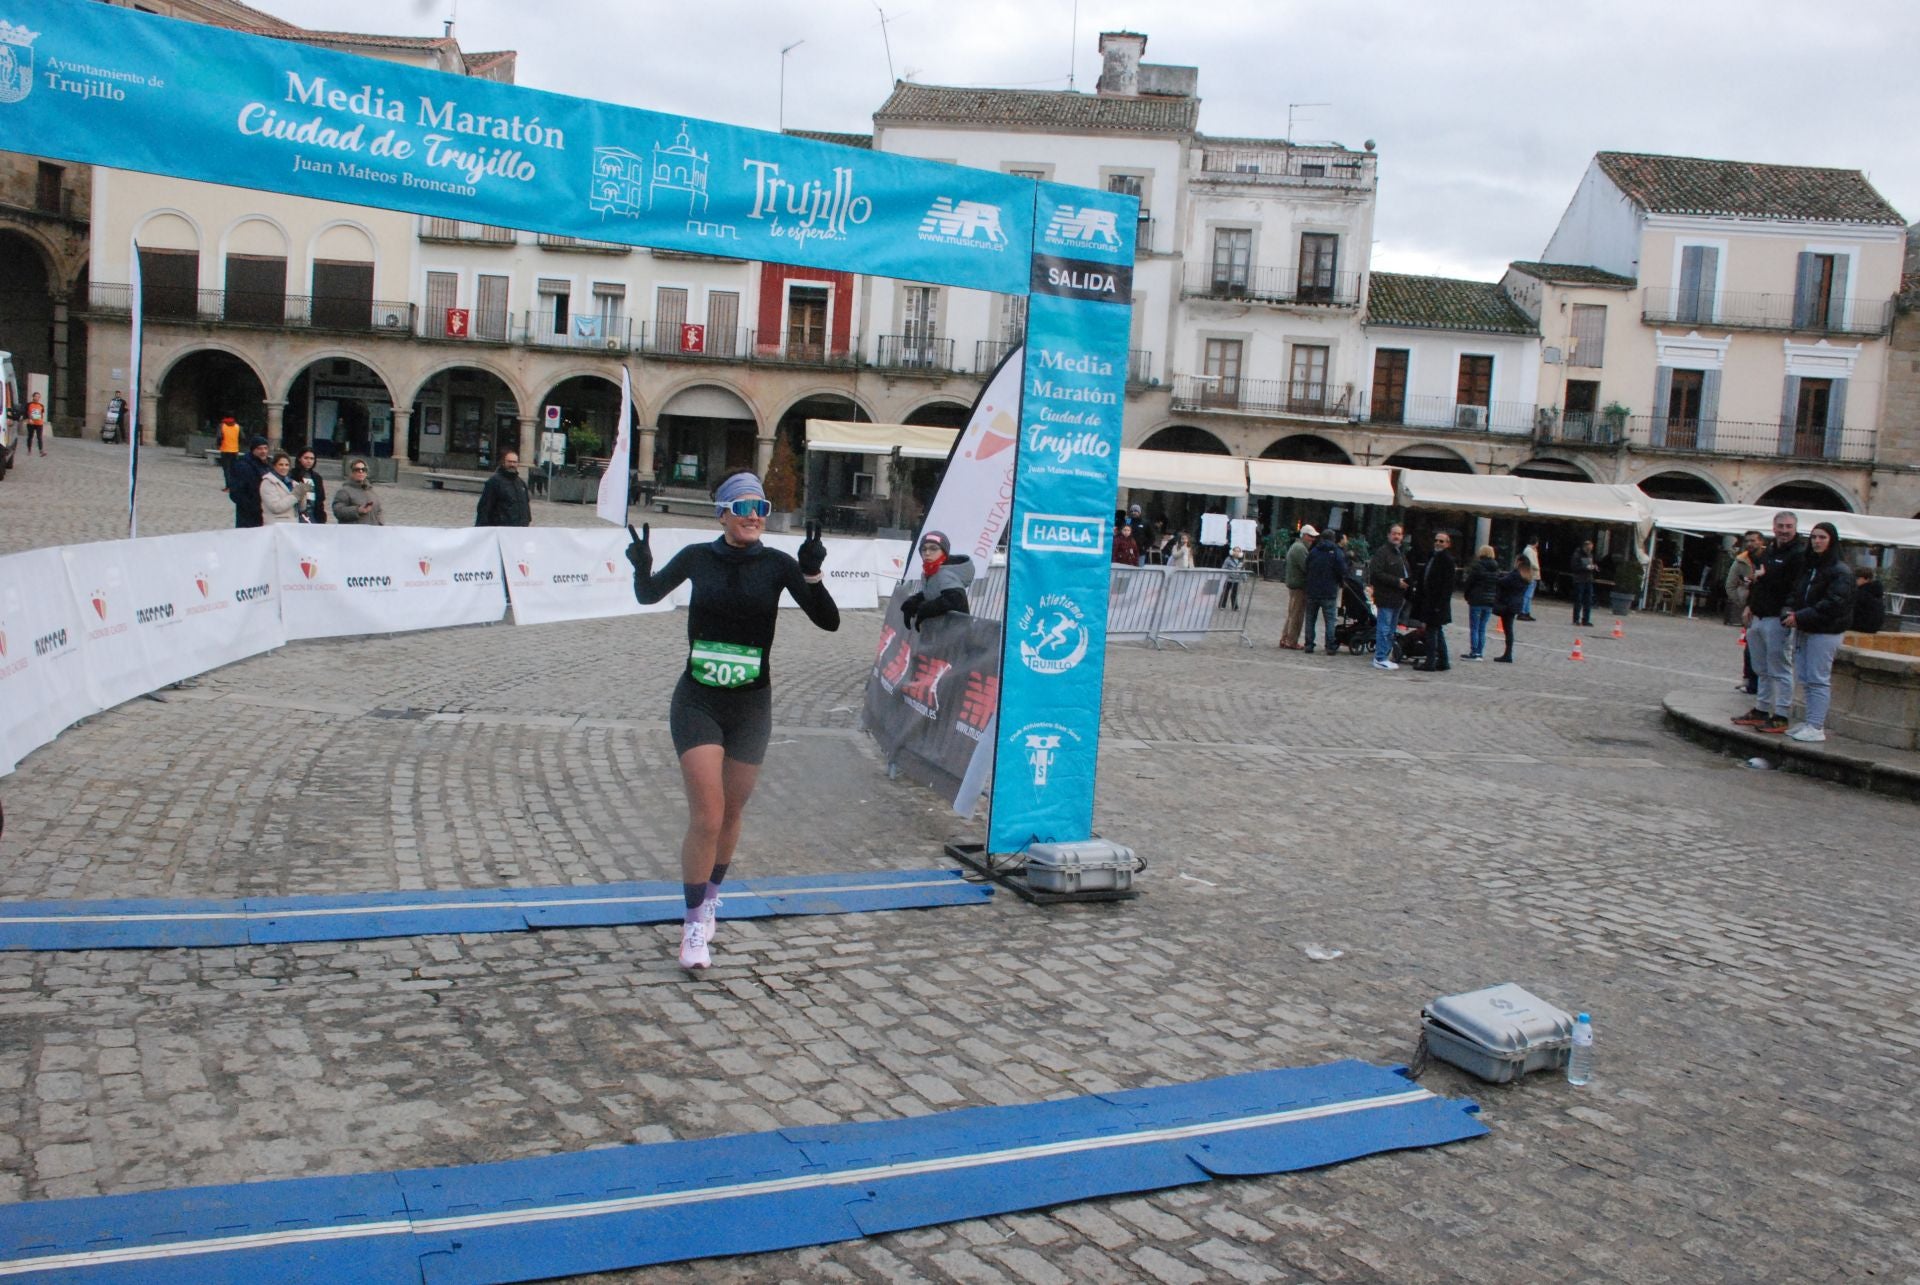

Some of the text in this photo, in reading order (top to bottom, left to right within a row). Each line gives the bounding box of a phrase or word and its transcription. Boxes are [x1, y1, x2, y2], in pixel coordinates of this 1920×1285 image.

[47, 56, 165, 88] Ayuntamiento de
[44, 72, 126, 101] Trujillo
[285, 71, 565, 150] Media Maratón
[238, 102, 536, 184] Ciudad de Trujillo
[293, 155, 477, 197] Juan Mateos Broncano
[743, 158, 873, 235] Trujillo
[770, 216, 785, 237] te
[918, 232, 1004, 251] www.musicrun.es
[1044, 236, 1118, 253] www.musicrun.es
[1048, 267, 1116, 293] SALIDA
[1040, 349, 1113, 376] Media
[1032, 379, 1117, 405] Maratón
[1040, 407, 1102, 426] Ciudad de
[1028, 424, 1111, 463] Trujillo
[974, 462, 1015, 560] DIPUTACIÓ
[1034, 525, 1092, 543] HABLA
[1019, 592, 1084, 631] Club Atletismo
[703, 661, 746, 686] 203
